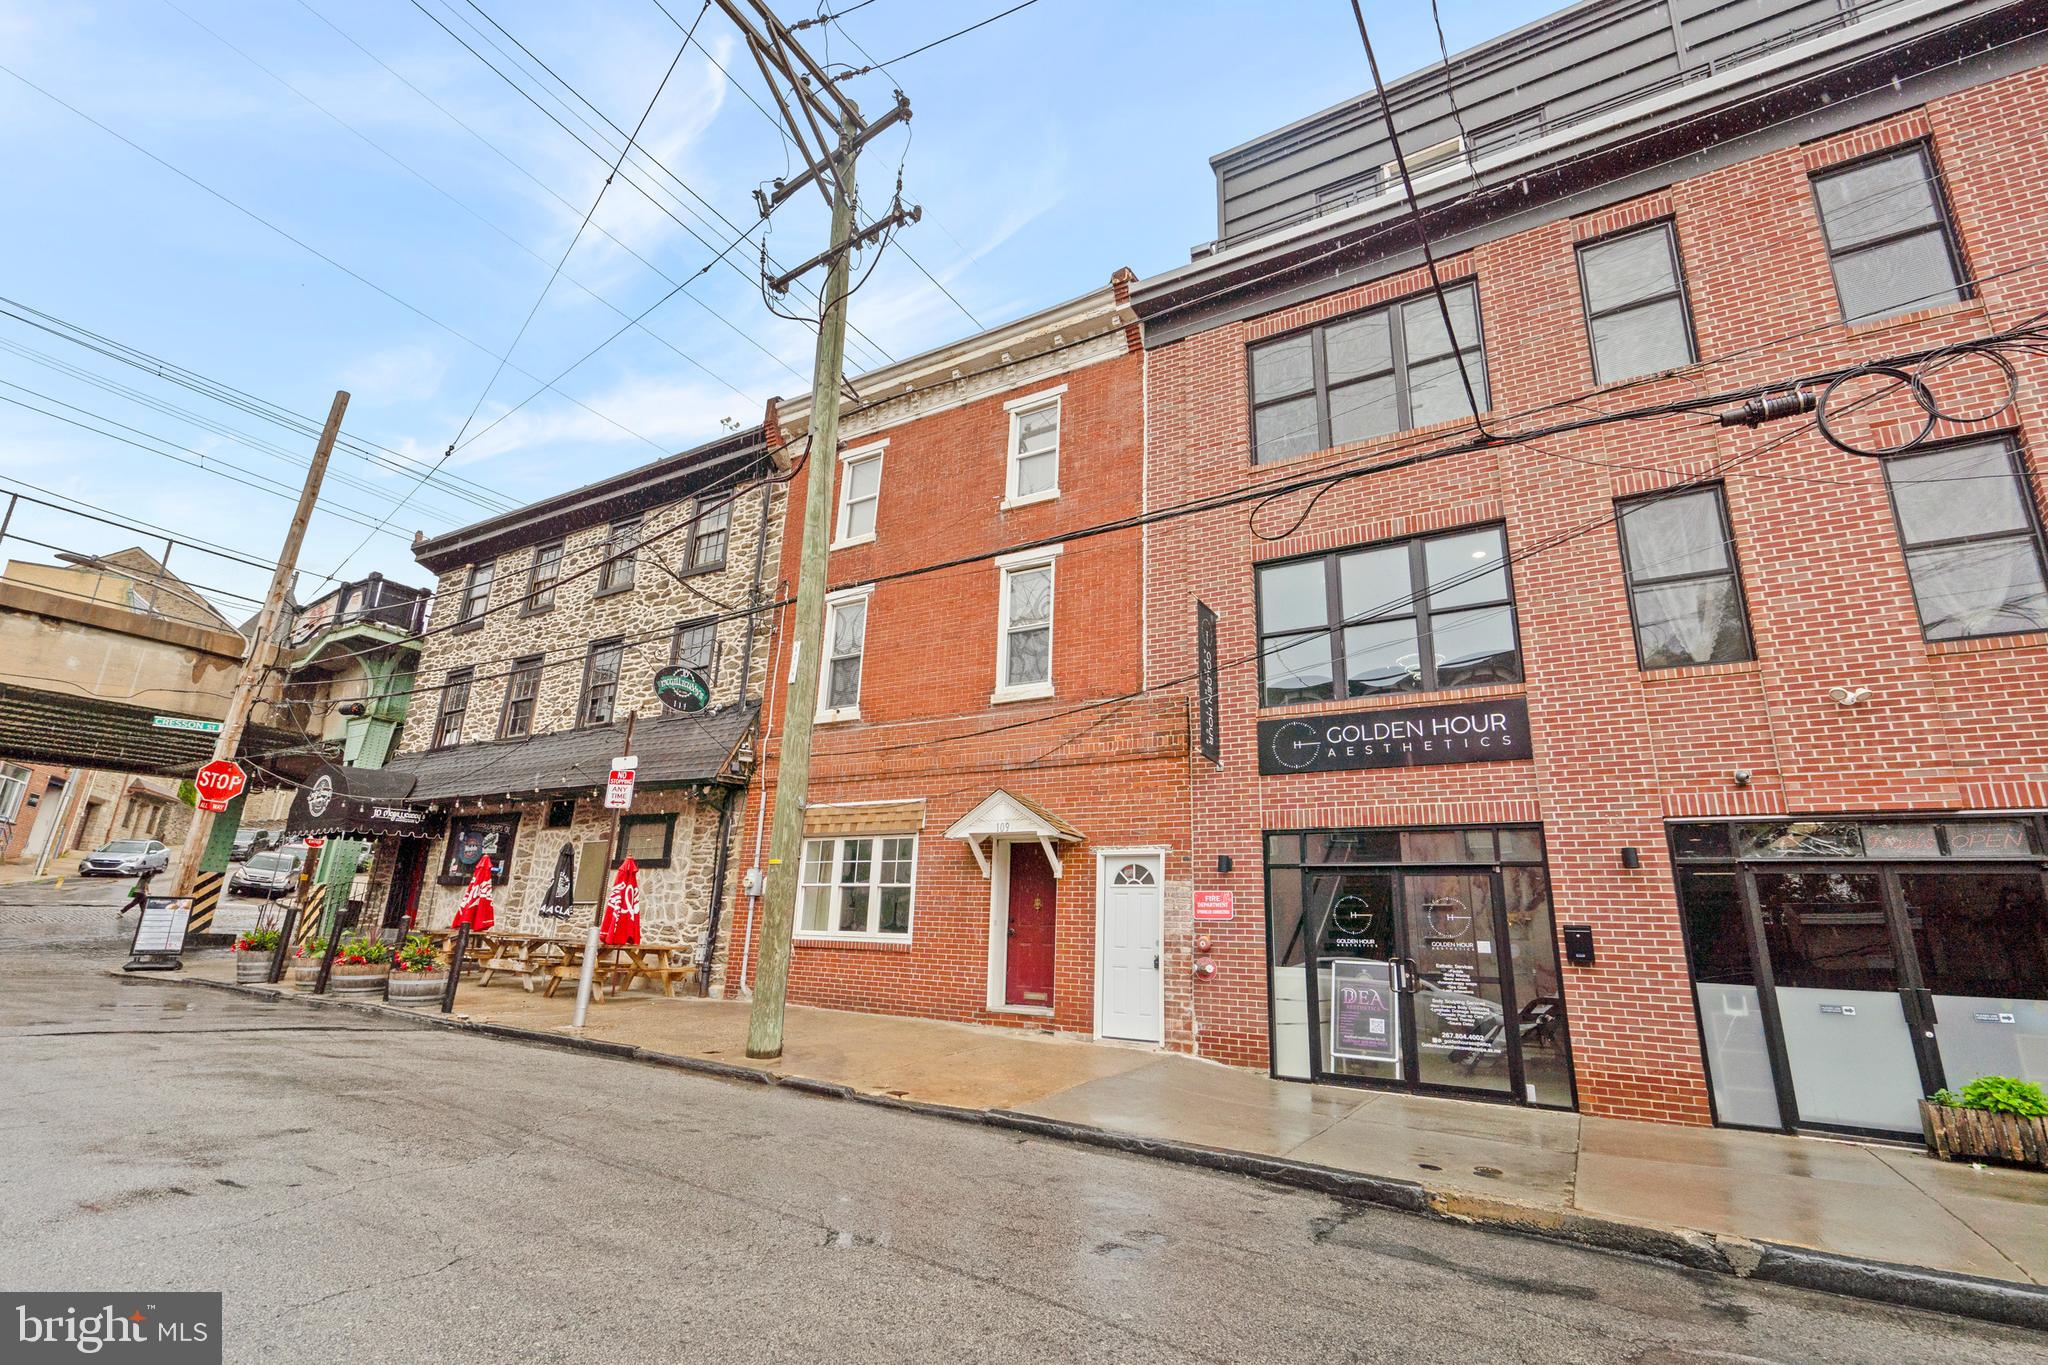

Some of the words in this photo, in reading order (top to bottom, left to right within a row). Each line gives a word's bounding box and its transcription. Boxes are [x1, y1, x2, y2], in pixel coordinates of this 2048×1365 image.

[155, 717, 204, 730] CRESSON
[1206, 706, 1214, 745] HOUR
[1326, 719, 1424, 744] GOLDEN
[1432, 712, 1508, 736] HOUR
[1327, 734, 1512, 758] AESTHETICS
[199, 770, 242, 791] STOP
[617, 771, 628, 780] NO
[996, 822, 1010, 832] 109
[1951, 831, 2024, 849] OPEN
[1340, 987, 1390, 1011] DEA
